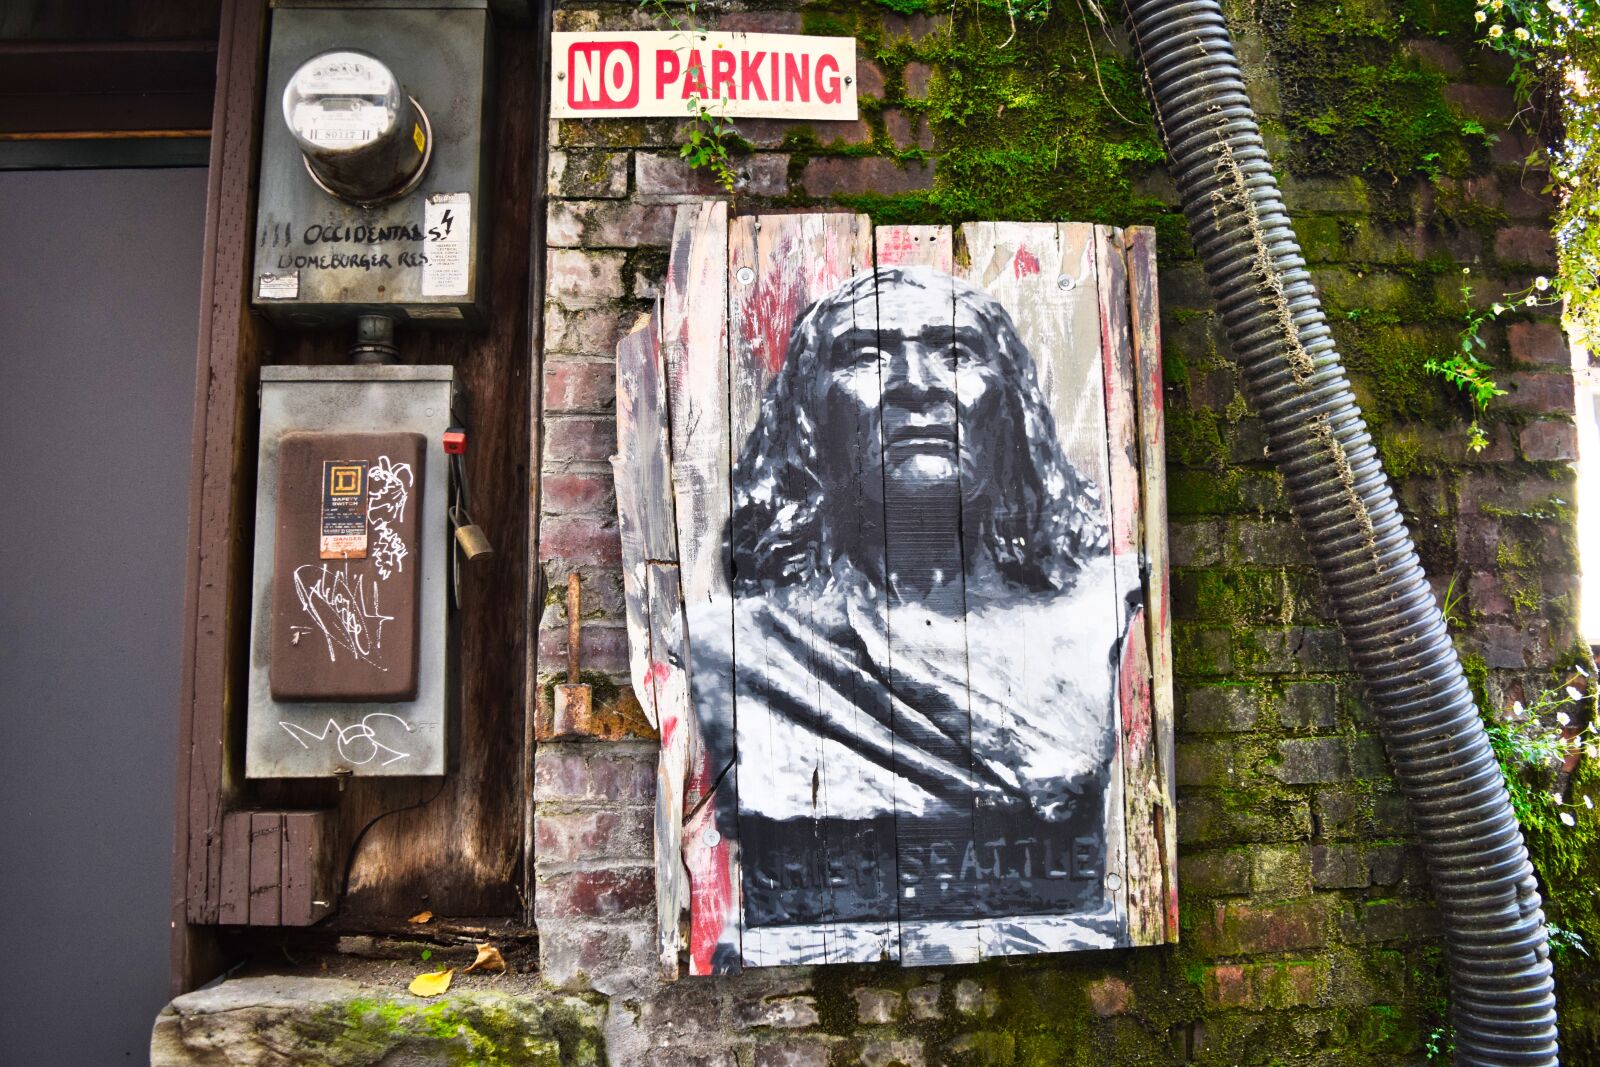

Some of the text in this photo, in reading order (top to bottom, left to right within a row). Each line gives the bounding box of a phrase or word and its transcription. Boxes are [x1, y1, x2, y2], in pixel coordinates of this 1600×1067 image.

[573, 48, 842, 104] NO PARKING
[901, 838, 1100, 881] SEATTLE
